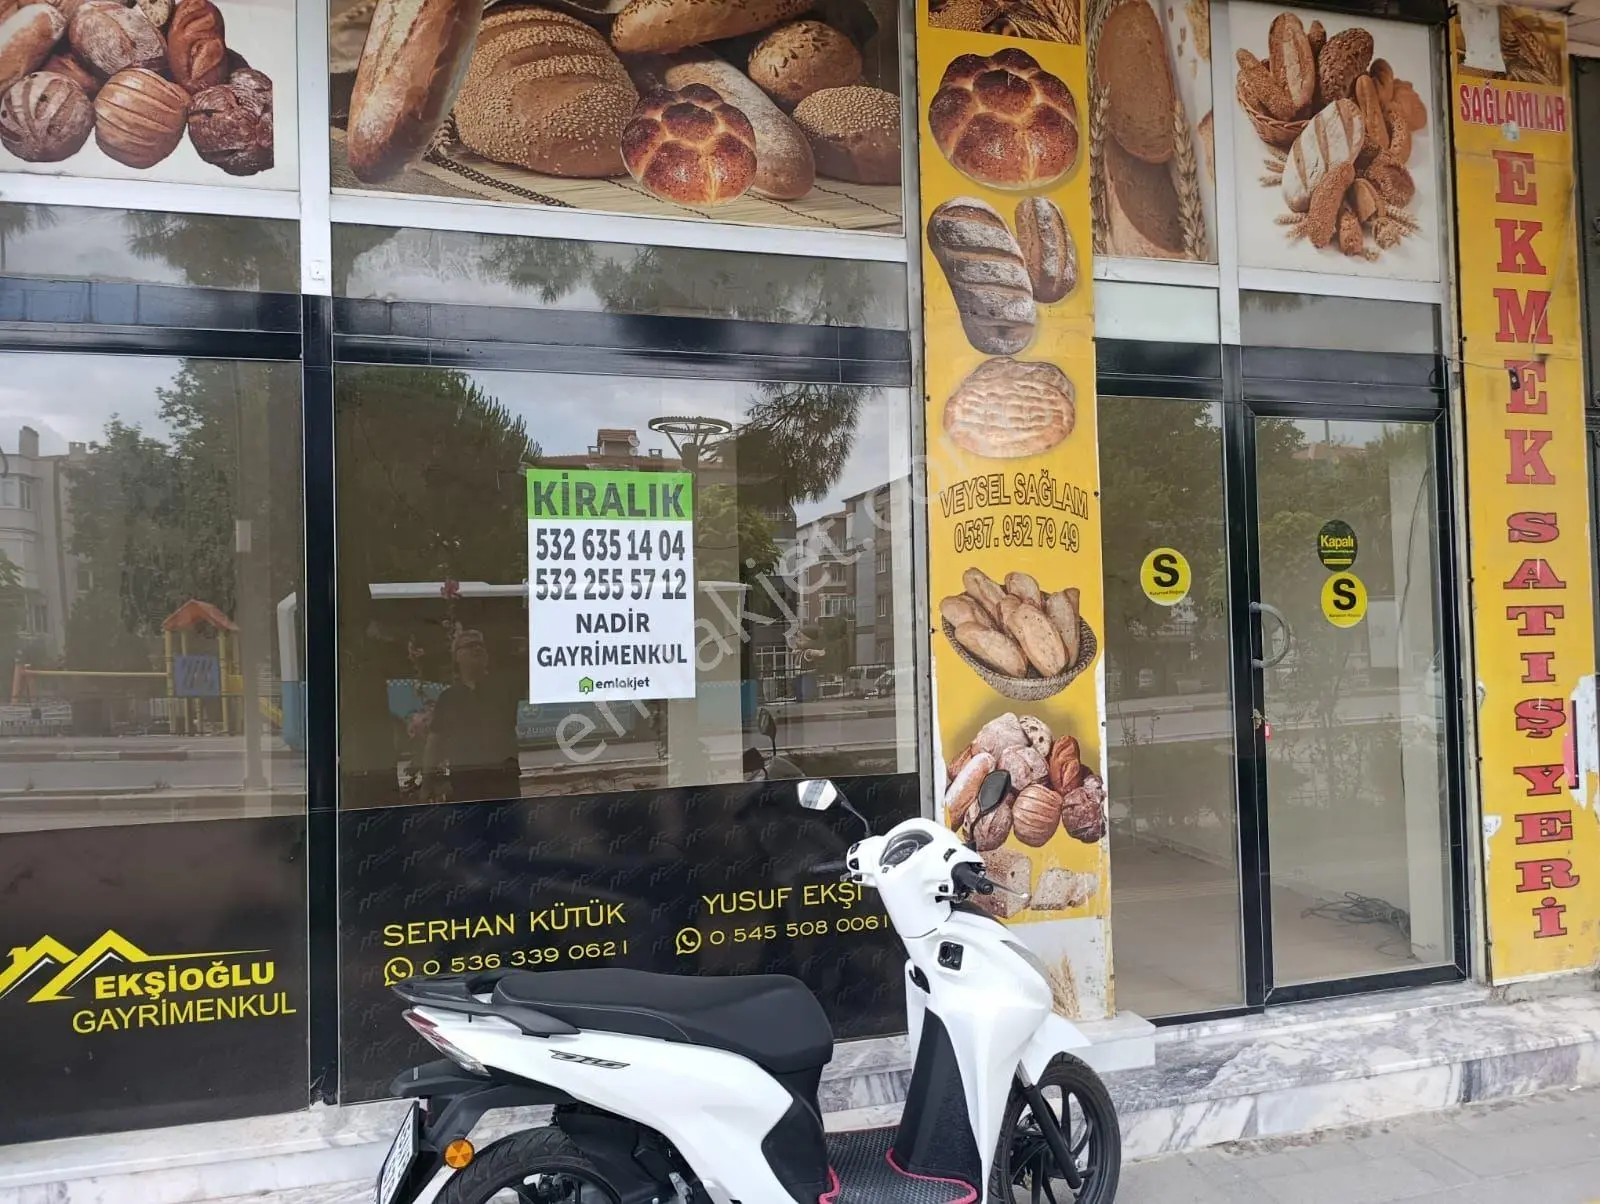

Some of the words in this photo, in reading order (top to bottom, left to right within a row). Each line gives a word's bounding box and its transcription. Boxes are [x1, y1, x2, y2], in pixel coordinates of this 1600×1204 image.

[1459, 80, 1567, 132] SAĞLAMLAR
[1492, 149, 1557, 485] EKMEK
[533, 472, 686, 518] KİRALIK
[939, 473, 1011, 518] VEYSEL
[1013, 469, 1089, 520] SAĞLAM
[536, 528, 576, 561] 532
[582, 528, 622, 561] 635
[627, 529, 653, 561] 14
[658, 529, 686, 561] 04
[954, 516, 999, 553] 0537.
[1002, 515, 1033, 548] 952
[1036, 516, 1057, 549] 79
[1060, 521, 1080, 553] 49
[1320, 534, 1354, 550] Kapalı
[536, 567, 578, 600] 532
[583, 567, 624, 600] 255
[630, 568, 656, 600] 57
[661, 568, 687, 600] 12
[1153, 554, 1180, 588] S
[1332, 578, 1357, 611] S
[576, 608, 651, 634] NADİR
[1502, 511, 1567, 738] SATIŞ
[536, 641, 688, 667] GAYRİMENKUL
[595, 676, 651, 691] emlakjet
[1512, 764, 1580, 939] YERİ
[701, 887, 793, 915] YUSUF
[383, 912, 515, 947] SERHAN
[530, 899, 627, 933] KÜTÜK
[733, 925, 777, 943] 545
[786, 920, 829, 938] 508
[835, 914, 889, 933] 0061
[451, 953, 501, 973] 536
[510, 947, 560, 966] 339
[568, 939, 628, 960] 0621
[94, 960, 275, 1000] EKŞİOĞLU
[72, 991, 297, 1034] GAYRİMENKUL
